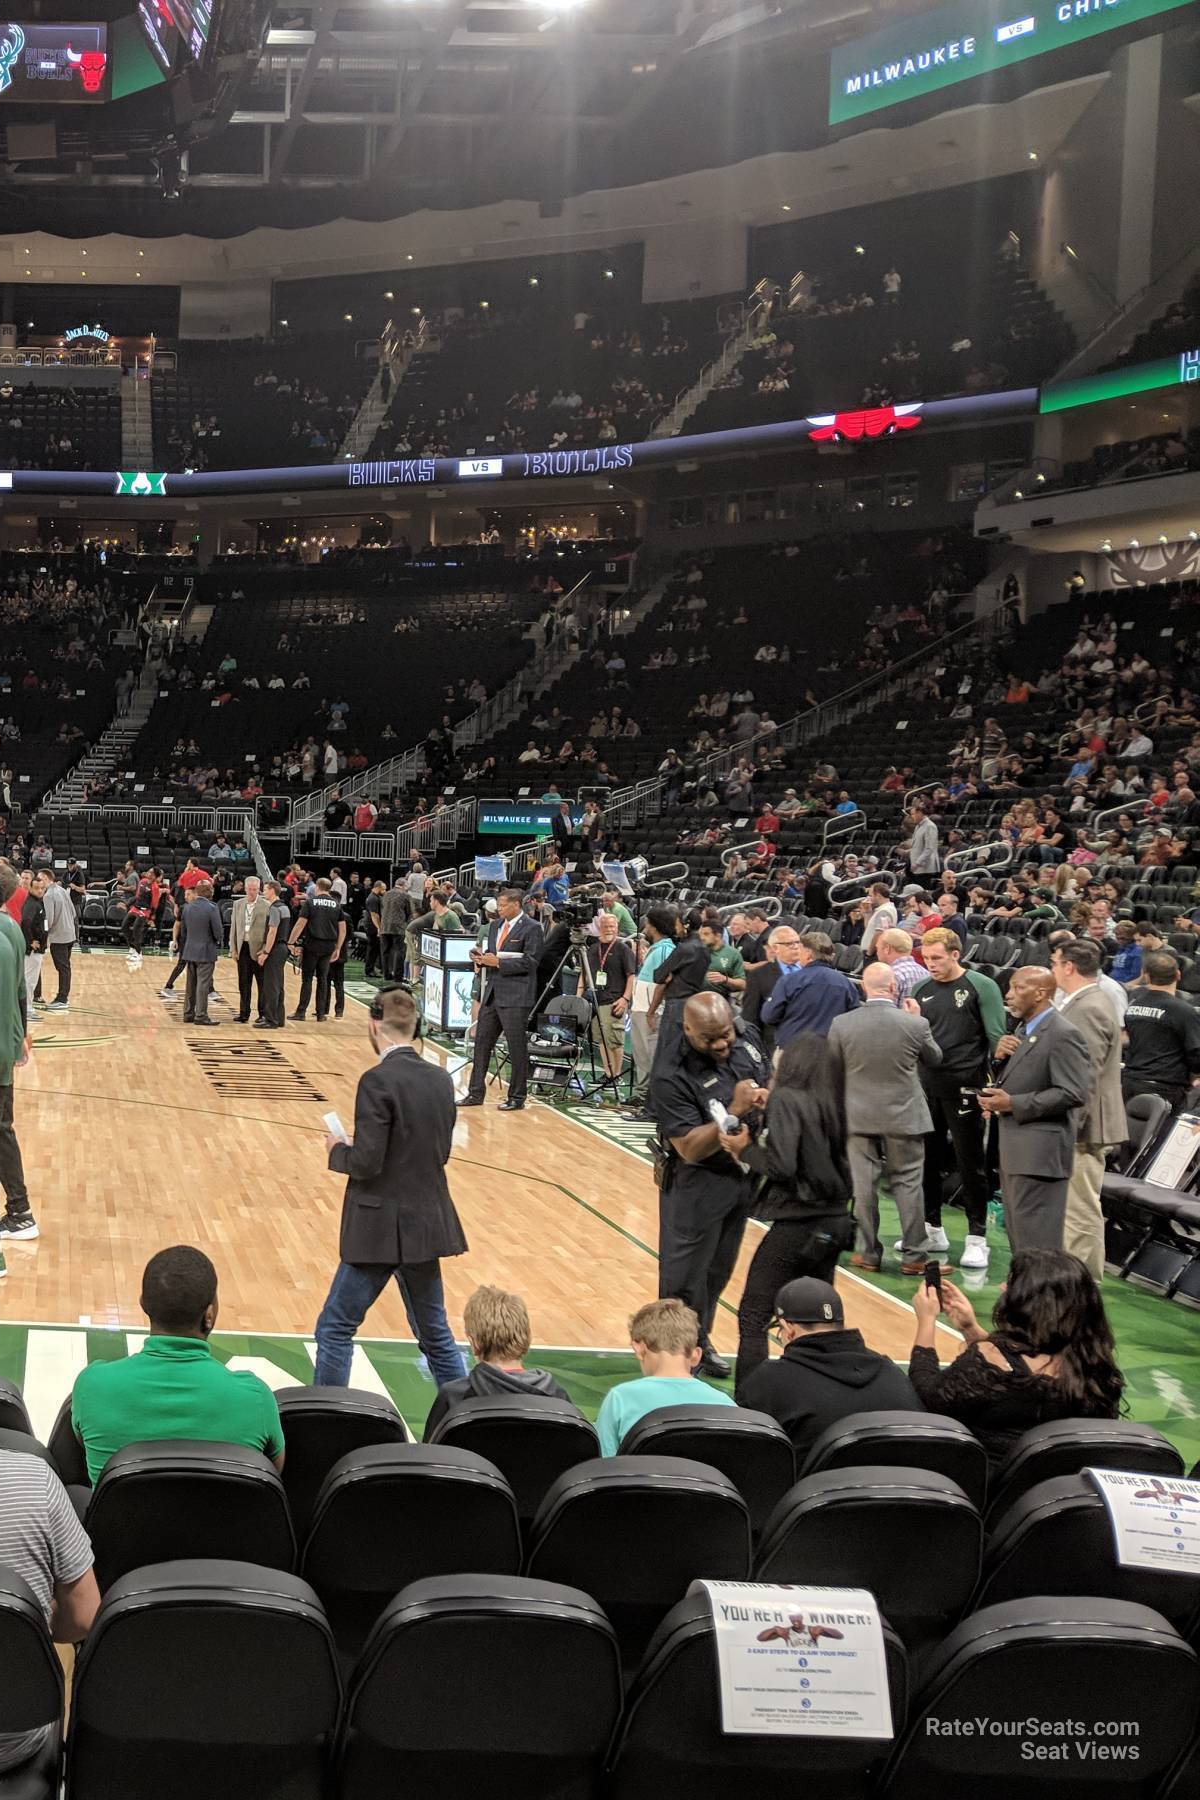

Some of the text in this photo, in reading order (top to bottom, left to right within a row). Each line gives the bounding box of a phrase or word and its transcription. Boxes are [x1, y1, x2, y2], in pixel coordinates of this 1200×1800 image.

[846, 37, 976, 94] MILWAUKEE
[1008, 25, 1023, 34] VS
[349, 444, 633, 485] BUCKS VS BULLS
[483, 815, 532, 824] MILWAUKEE
[312, 898, 337, 908] PHOTO
